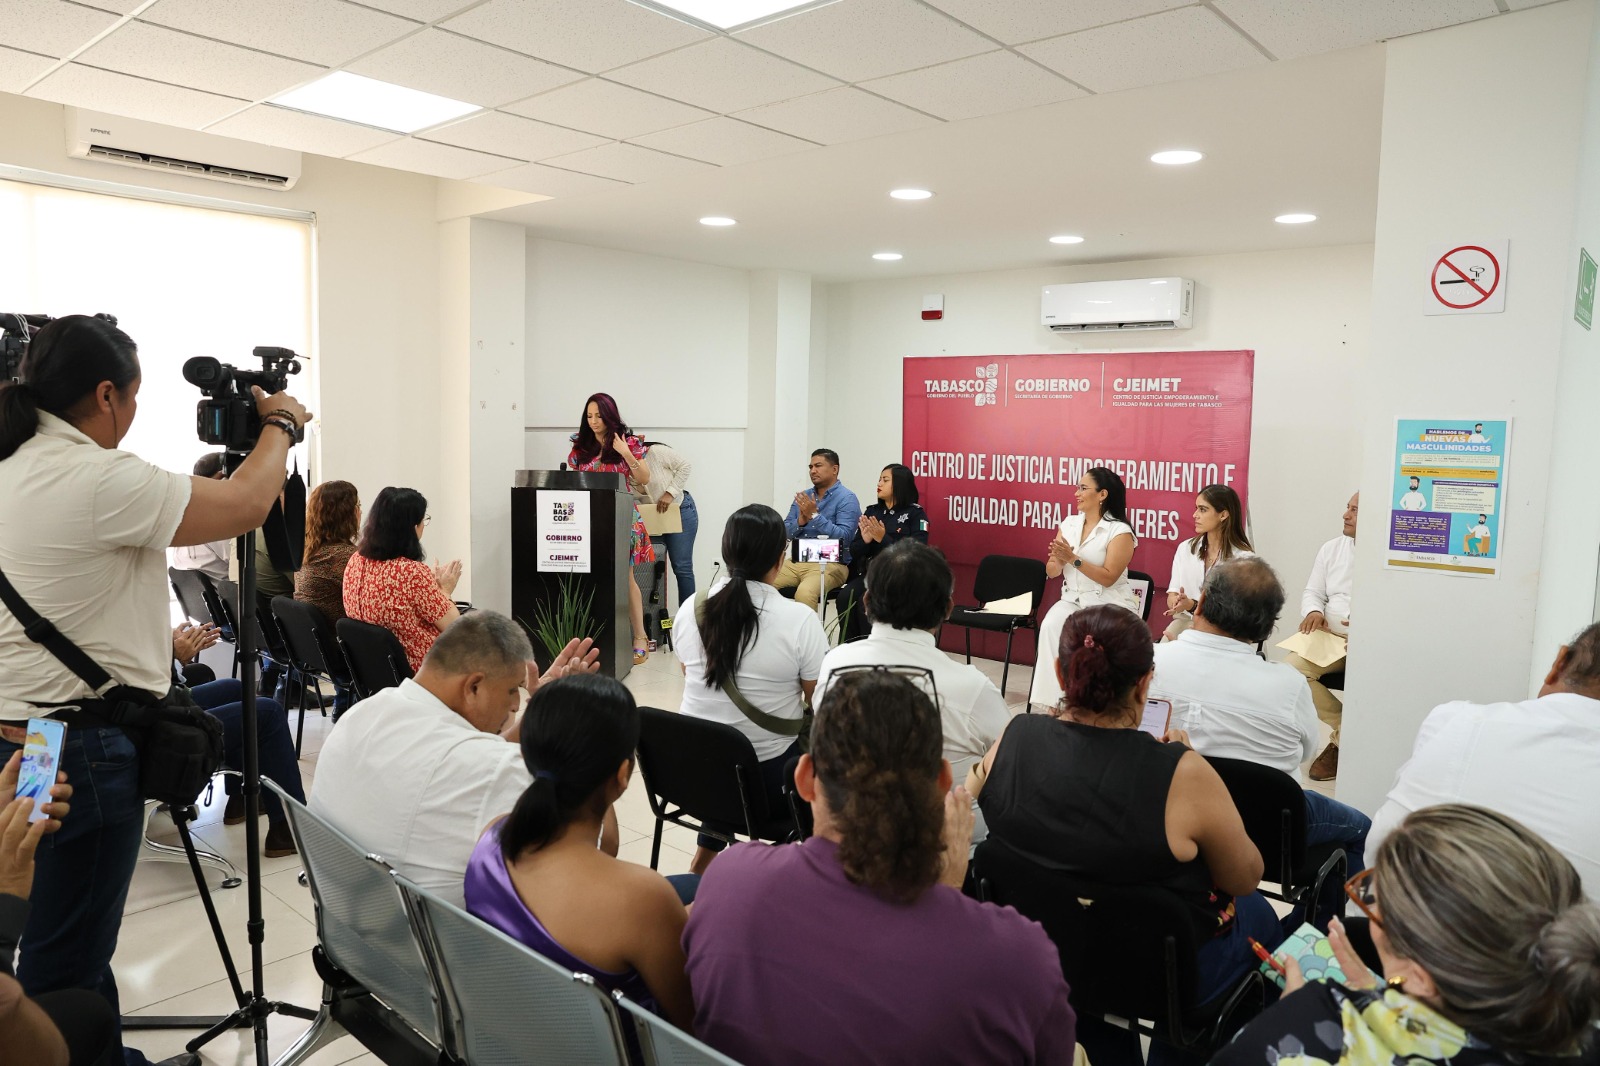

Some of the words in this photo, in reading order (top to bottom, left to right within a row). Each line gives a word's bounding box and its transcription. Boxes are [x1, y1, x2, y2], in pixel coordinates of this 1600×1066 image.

[924, 379, 985, 393] TABASCO
[1015, 378, 1091, 392] GOBIERNO
[1113, 377, 1182, 392] CJEIMET
[1425, 434, 1466, 442] NUEVAS
[1406, 443, 1492, 452] MASCULINIDADES
[911, 450, 964, 480] CENTRO
[968, 453, 987, 480] DE
[989, 454, 1054, 484] JUSTICIA
[948, 494, 1018, 527] IGUALDAD
[1022, 500, 1062, 530] PARA
